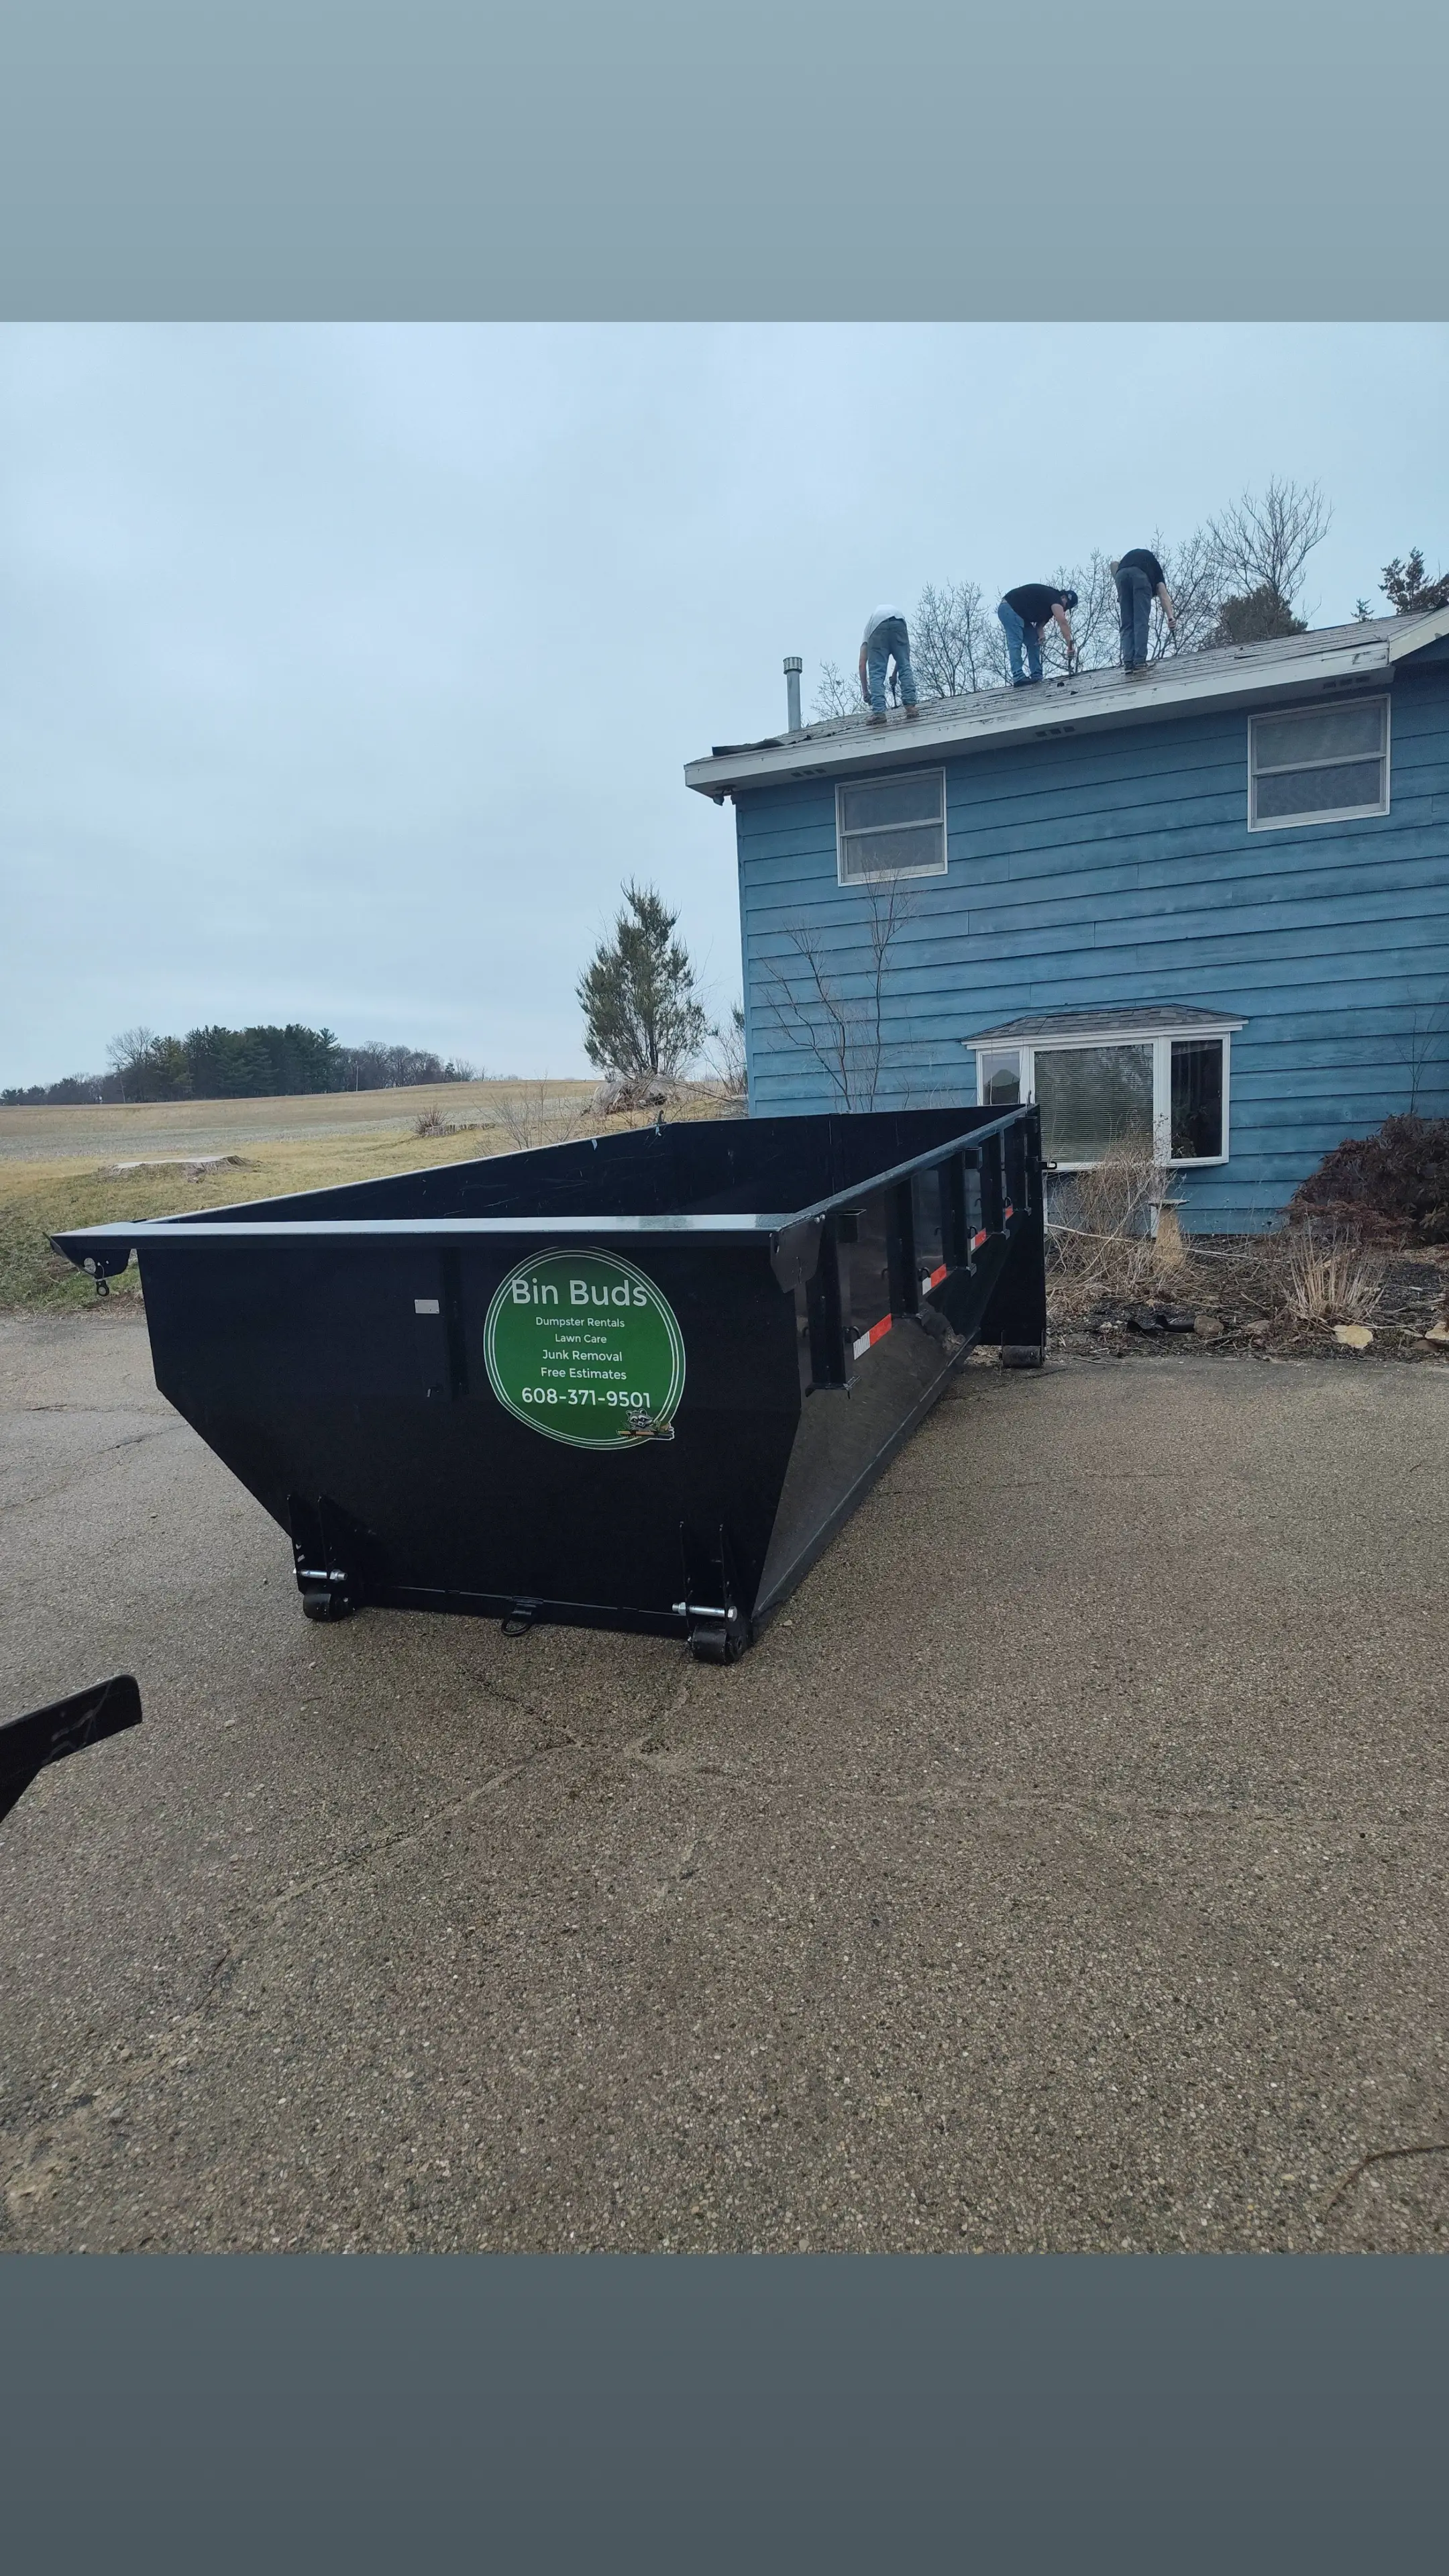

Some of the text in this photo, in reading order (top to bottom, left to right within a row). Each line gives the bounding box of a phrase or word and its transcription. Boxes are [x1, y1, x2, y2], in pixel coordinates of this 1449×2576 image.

[512, 1278, 647, 1307] Bin Buds
[535, 1317, 625, 1328] Dumpster Rentals
[555, 1334, 607, 1344] Lawn Care
[542, 1350, 623, 1362] Junk Removal
[541, 1367, 627, 1380] Free Estimates
[521, 1387, 651, 1408] 608-371-9501
